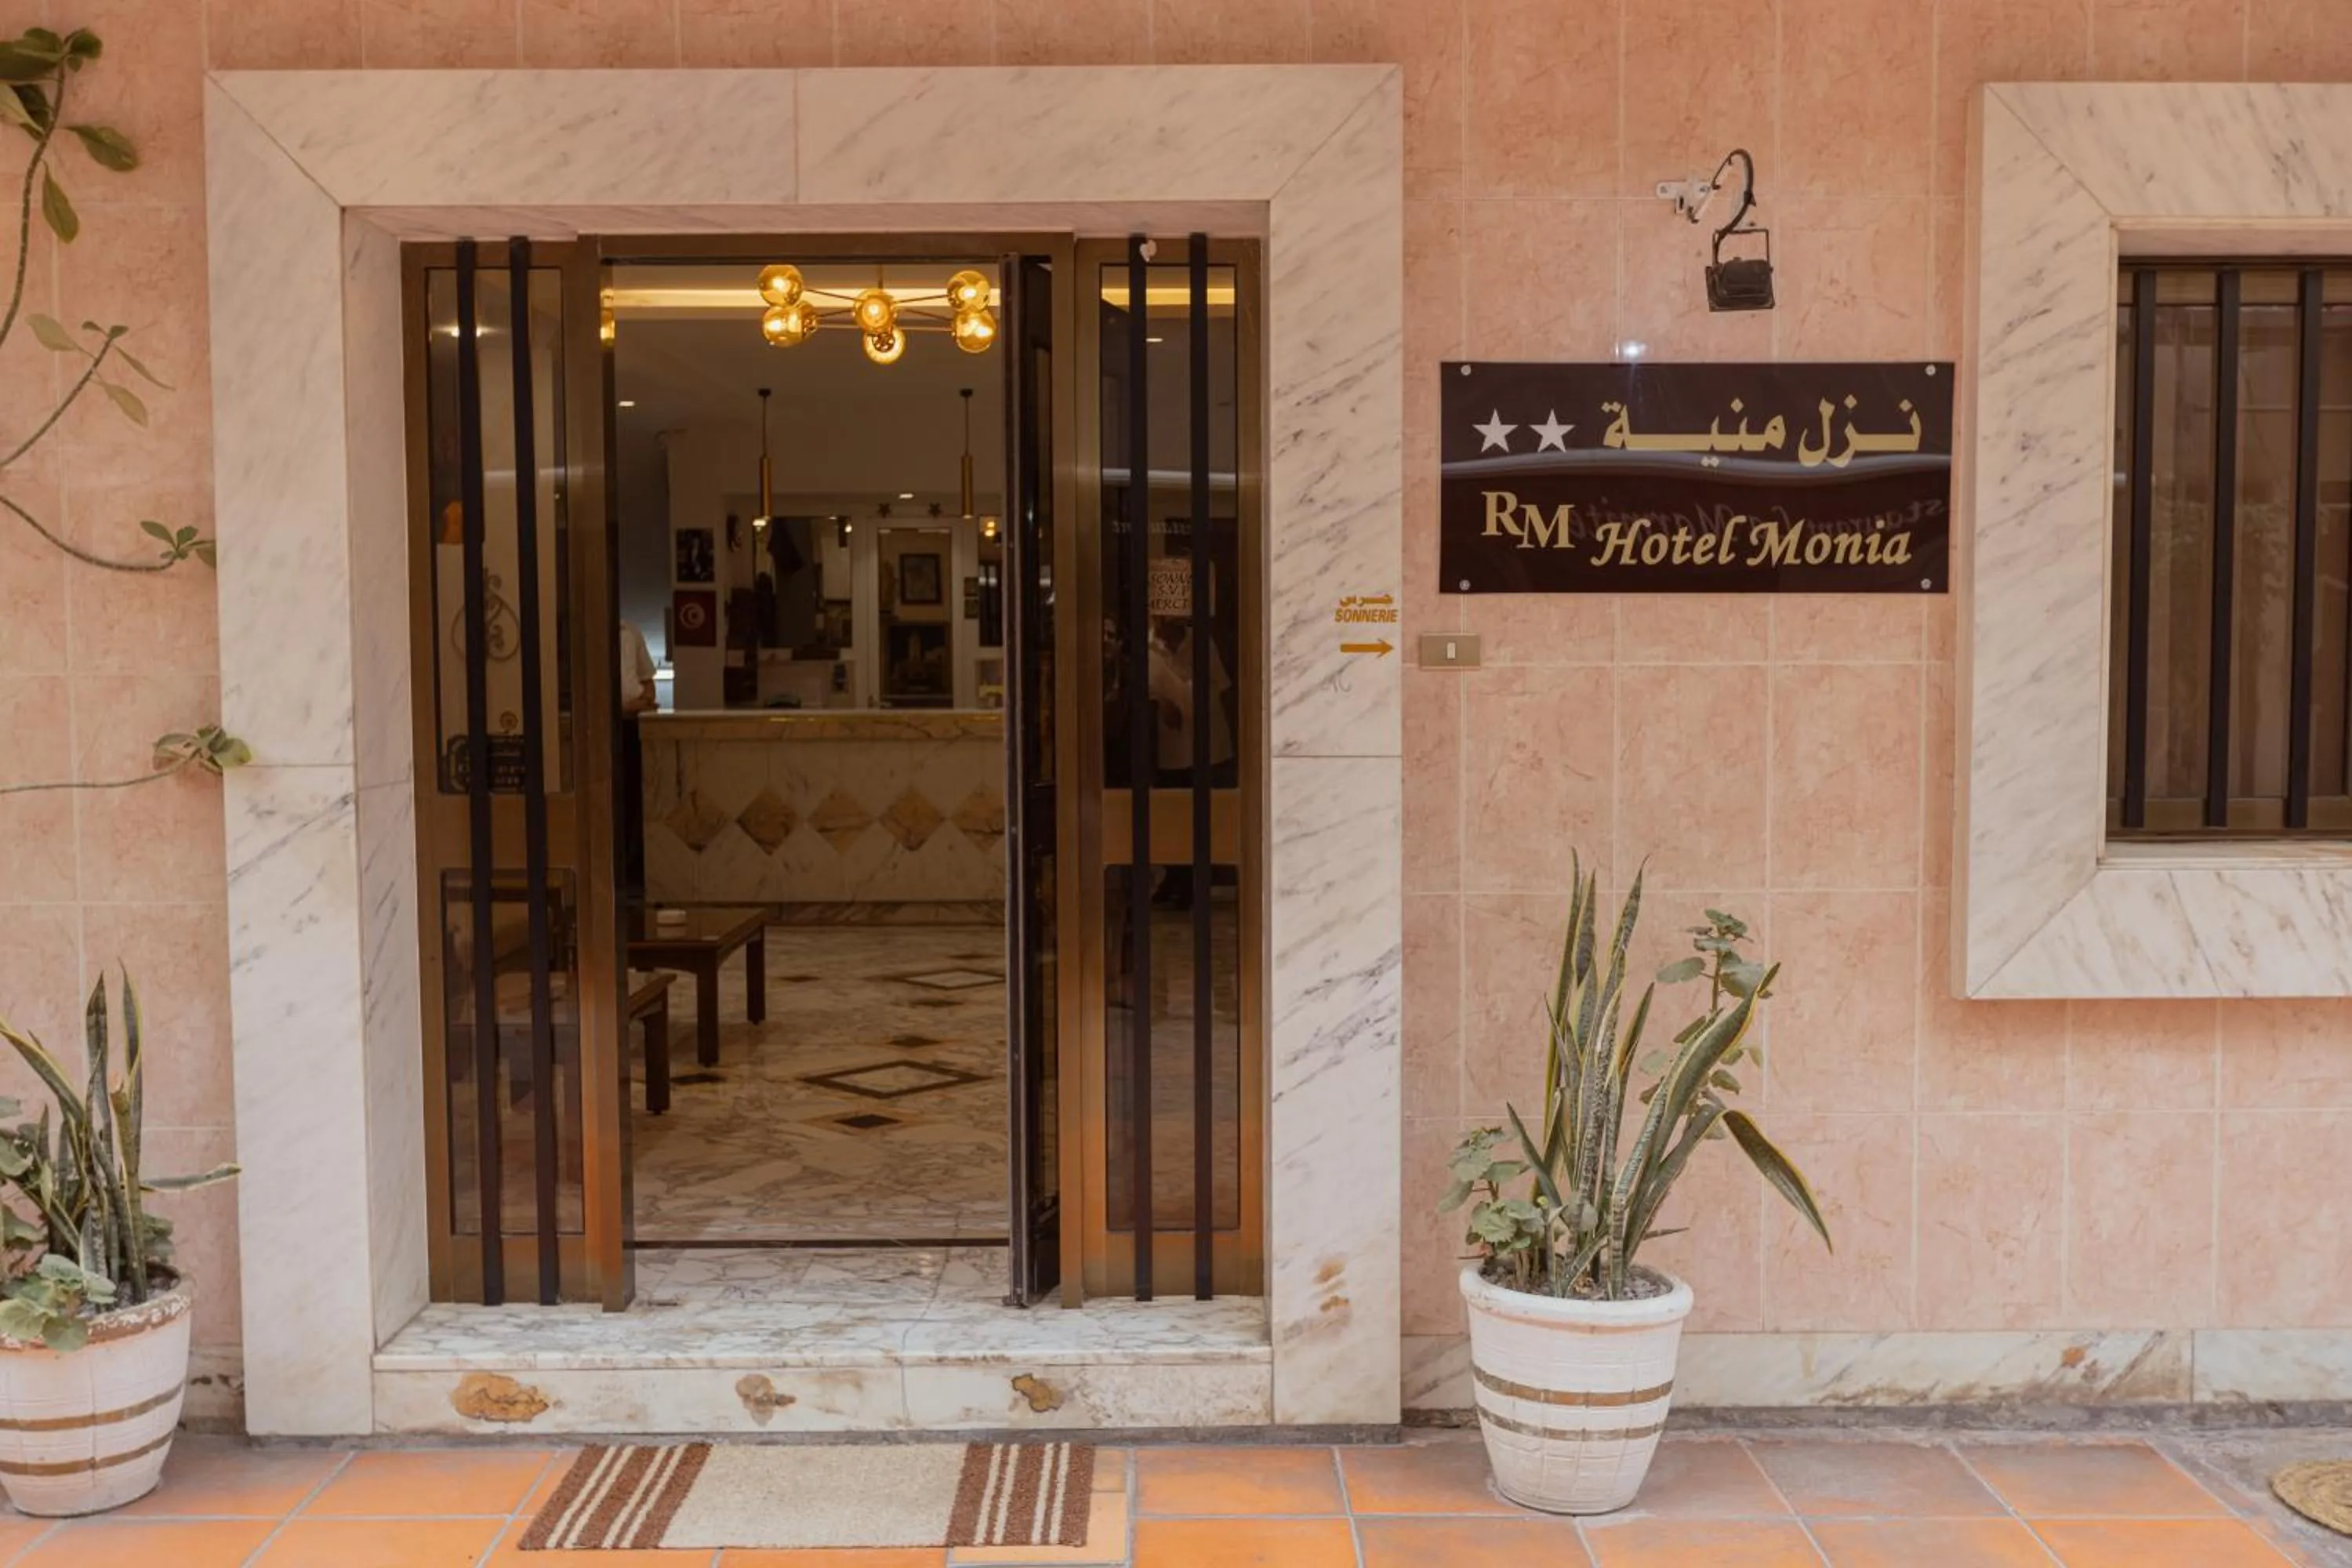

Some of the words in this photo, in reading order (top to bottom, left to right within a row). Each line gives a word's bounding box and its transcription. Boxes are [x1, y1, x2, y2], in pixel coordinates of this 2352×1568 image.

[1600, 397, 1788, 467] منية
[1798, 394, 1922, 466] نزل
[1480, 490, 1576, 549] RM
[1590, 515, 1746, 566] Hotel
[1745, 520, 1913, 566] Monia
[1334, 608, 1399, 623] SONNERIE
